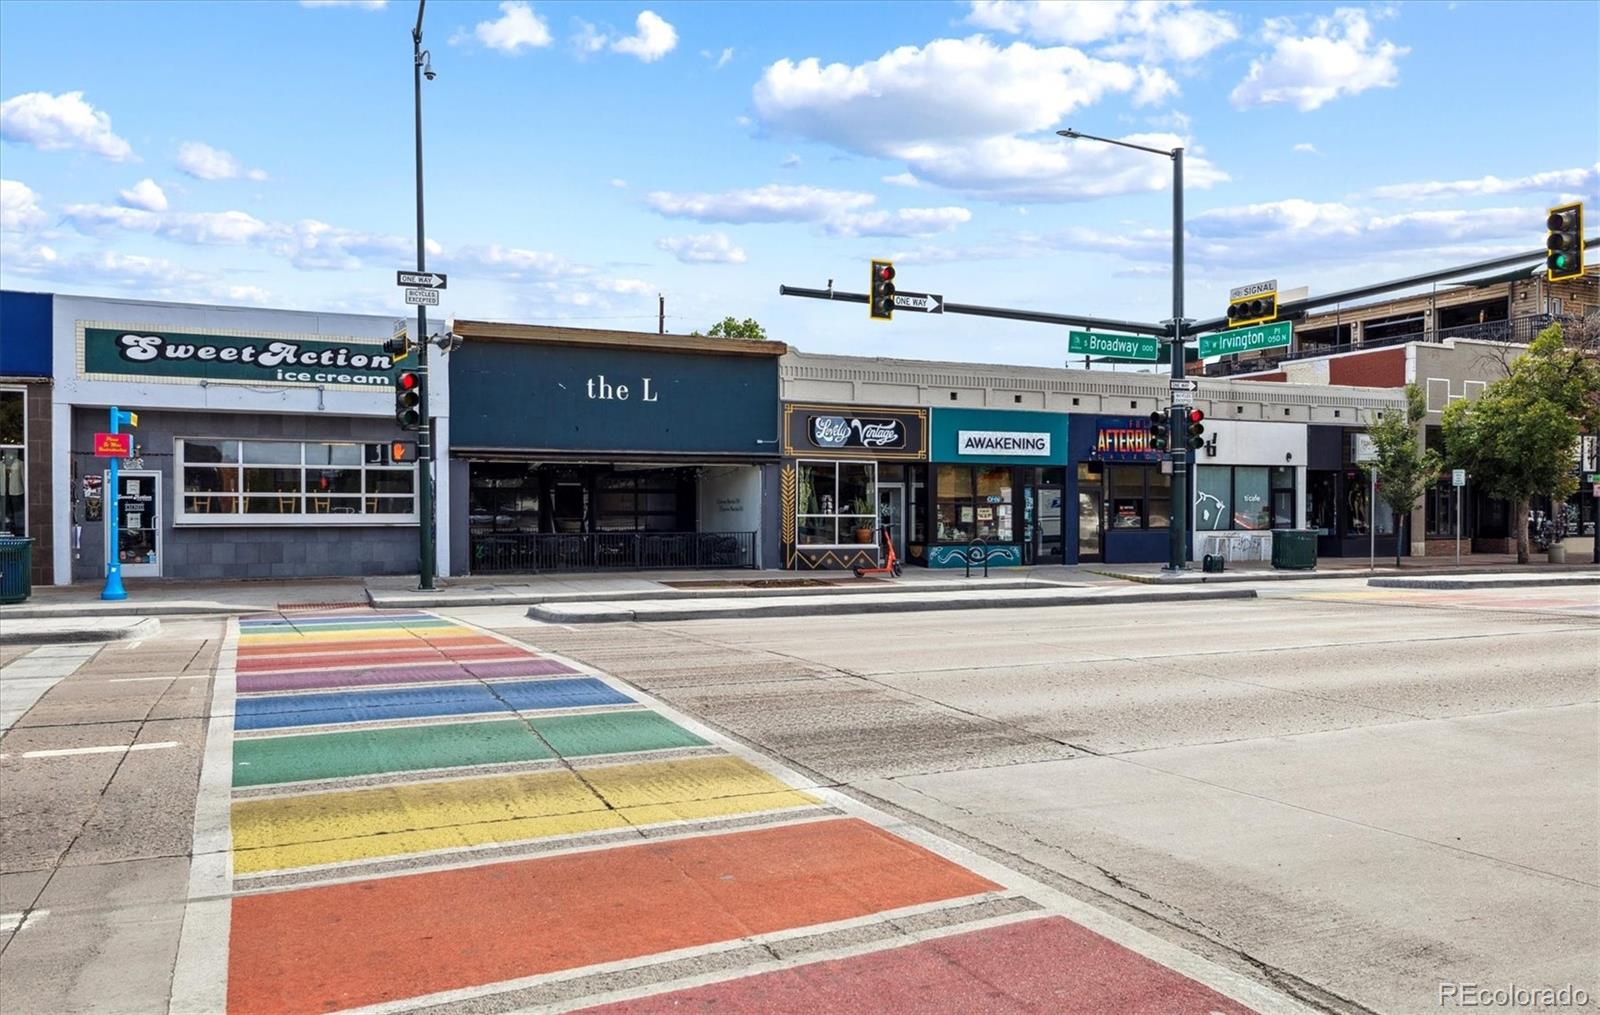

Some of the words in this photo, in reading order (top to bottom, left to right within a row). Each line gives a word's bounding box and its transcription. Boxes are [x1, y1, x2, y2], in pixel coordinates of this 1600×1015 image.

[1243, 283, 1274, 296] SIGNAL
[895, 296, 910, 305] ONE
[912, 299, 927, 307] WAY
[1089, 335, 1139, 357] Broadway
[1219, 331, 1265, 350] Irvington
[121, 334, 256, 362] Sweet
[257, 341, 392, 370] Action
[276, 369, 311, 381] ice
[314, 373, 390, 385] cream
[586, 374, 629, 401] the
[642, 376, 658, 402] L
[815, 417, 852, 443] Lovely
[851, 417, 899, 448] Vintage
[1097, 428, 1172, 453] AFTERBU
[964, 436, 1046, 451] AWAKENING
